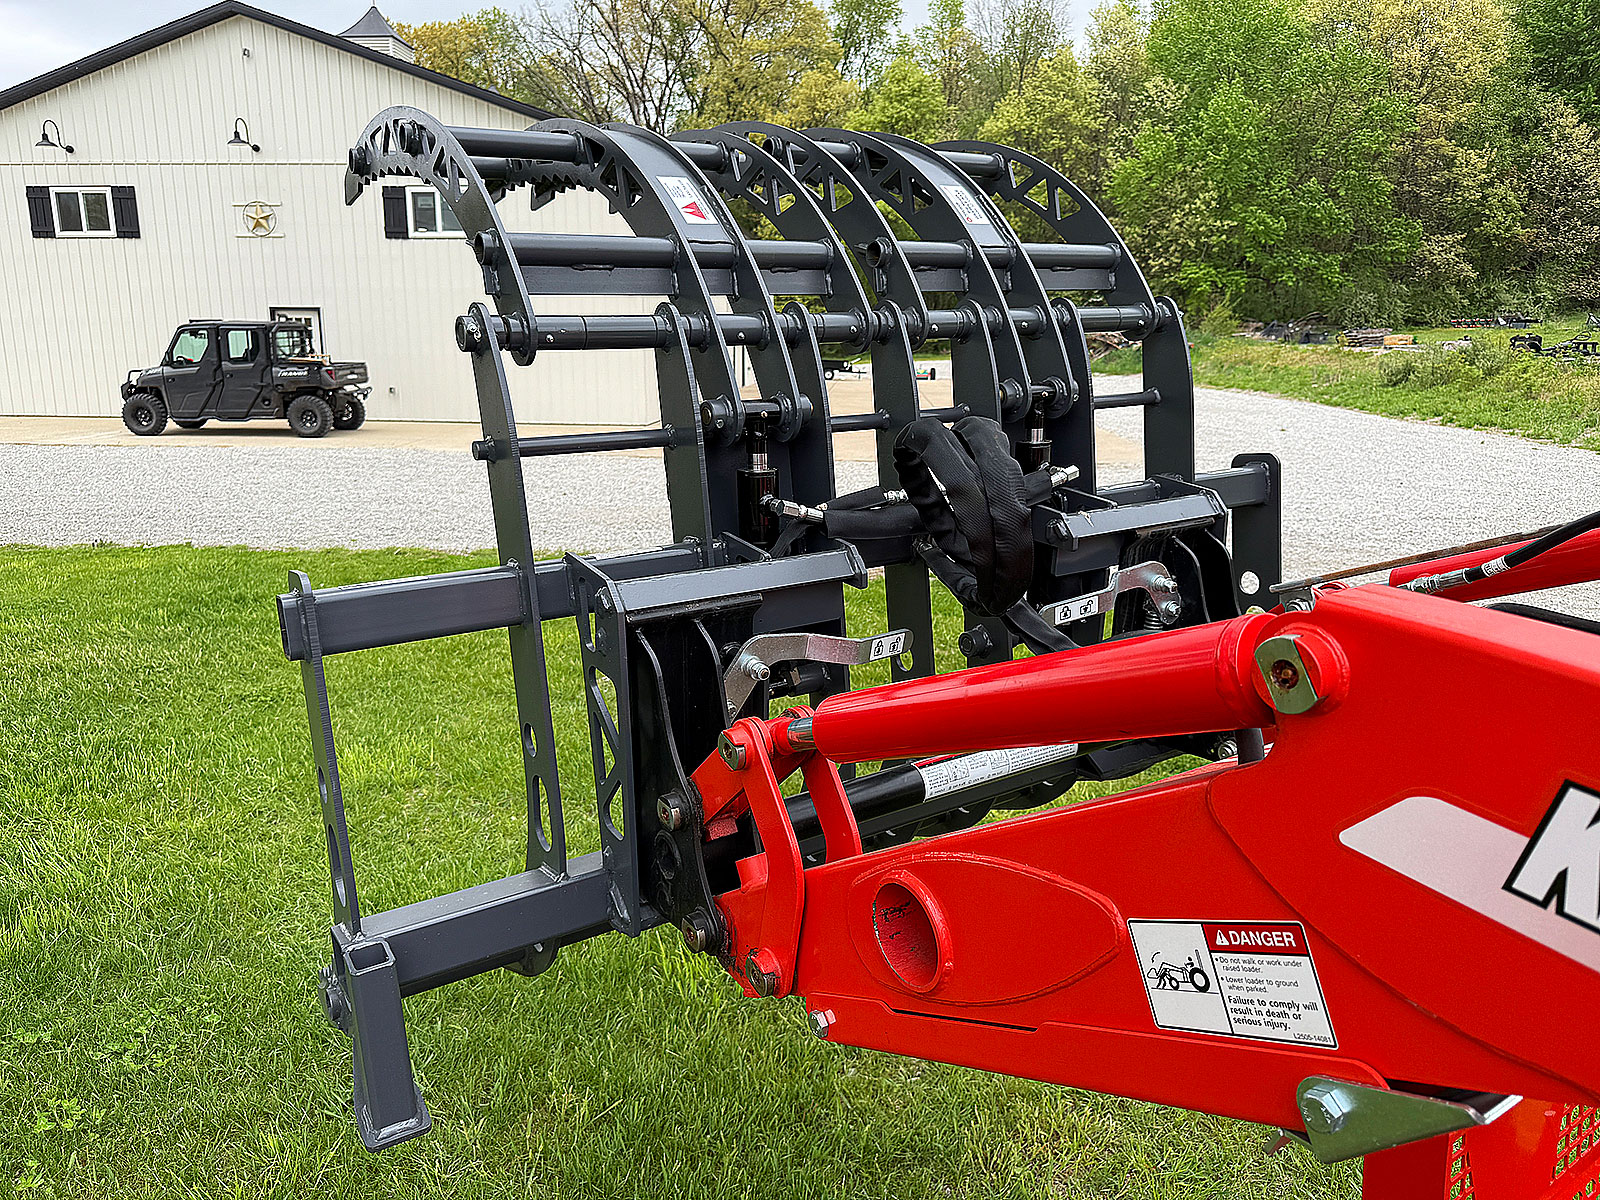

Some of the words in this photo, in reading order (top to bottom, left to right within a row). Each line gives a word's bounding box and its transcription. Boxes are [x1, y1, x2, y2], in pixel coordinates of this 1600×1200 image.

[1229, 930, 1296, 947] DANGER
[1219, 956, 1229, 964] Do
[1230, 957, 1241, 965] not
[1241, 965, 1264, 973] loader.
[1225, 976, 1244, 984] Lower
[1244, 977, 1264, 985] loader
[1275, 980, 1299, 988] ground
[1246, 985, 1269, 993] parked.
[1228, 995, 1255, 1006] Failure
[1256, 998, 1267, 1007] to
[1268, 1000, 1300, 1012] comply
[1302, 1002, 1319, 1012] will
[1230, 1006, 1254, 1016] result
[1255, 1007, 1264, 1017] in
[1265, 1009, 1290, 1020] death
[1292, 1012, 1302, 1020] or
[1232, 1016, 1262, 1027] serious
[1264, 1018, 1291, 1032] injury.
